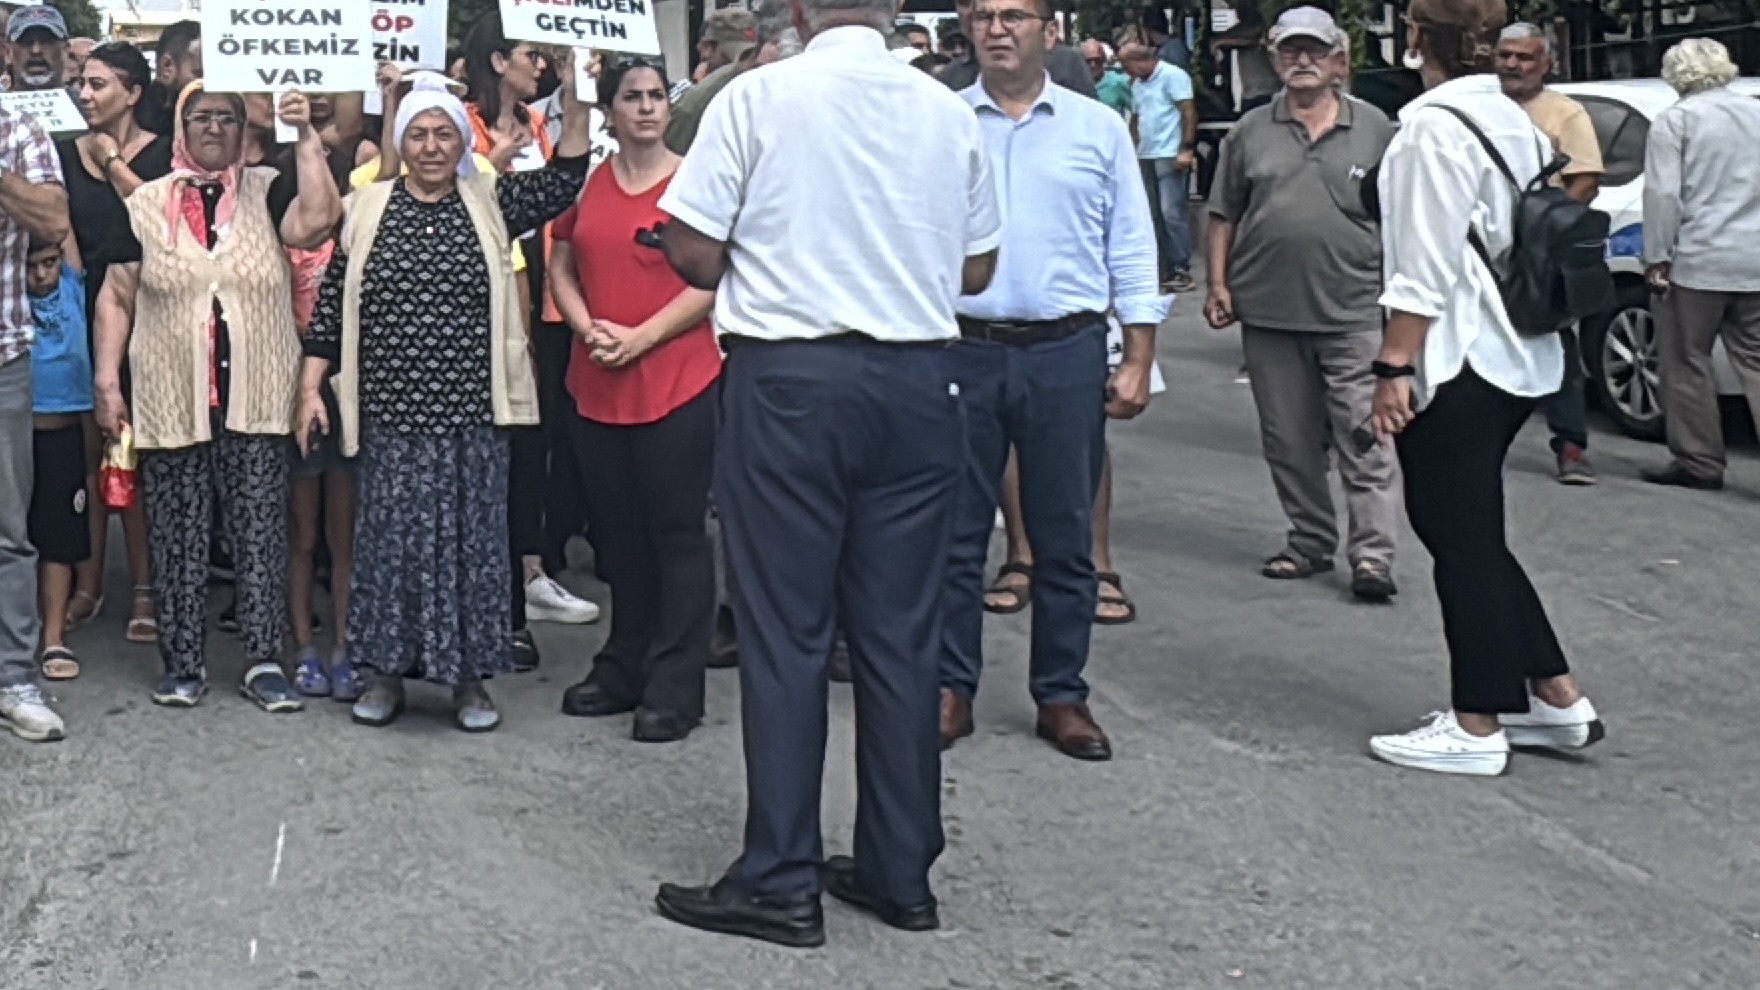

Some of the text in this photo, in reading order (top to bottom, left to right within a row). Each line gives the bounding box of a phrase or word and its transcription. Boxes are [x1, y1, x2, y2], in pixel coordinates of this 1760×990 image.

[230, 9, 343, 26] KOKAN
[535, 13, 628, 40] GEÇTİN
[217, 32, 360, 56] ÖFKEMİZ
[256, 68, 324, 85] VAR
